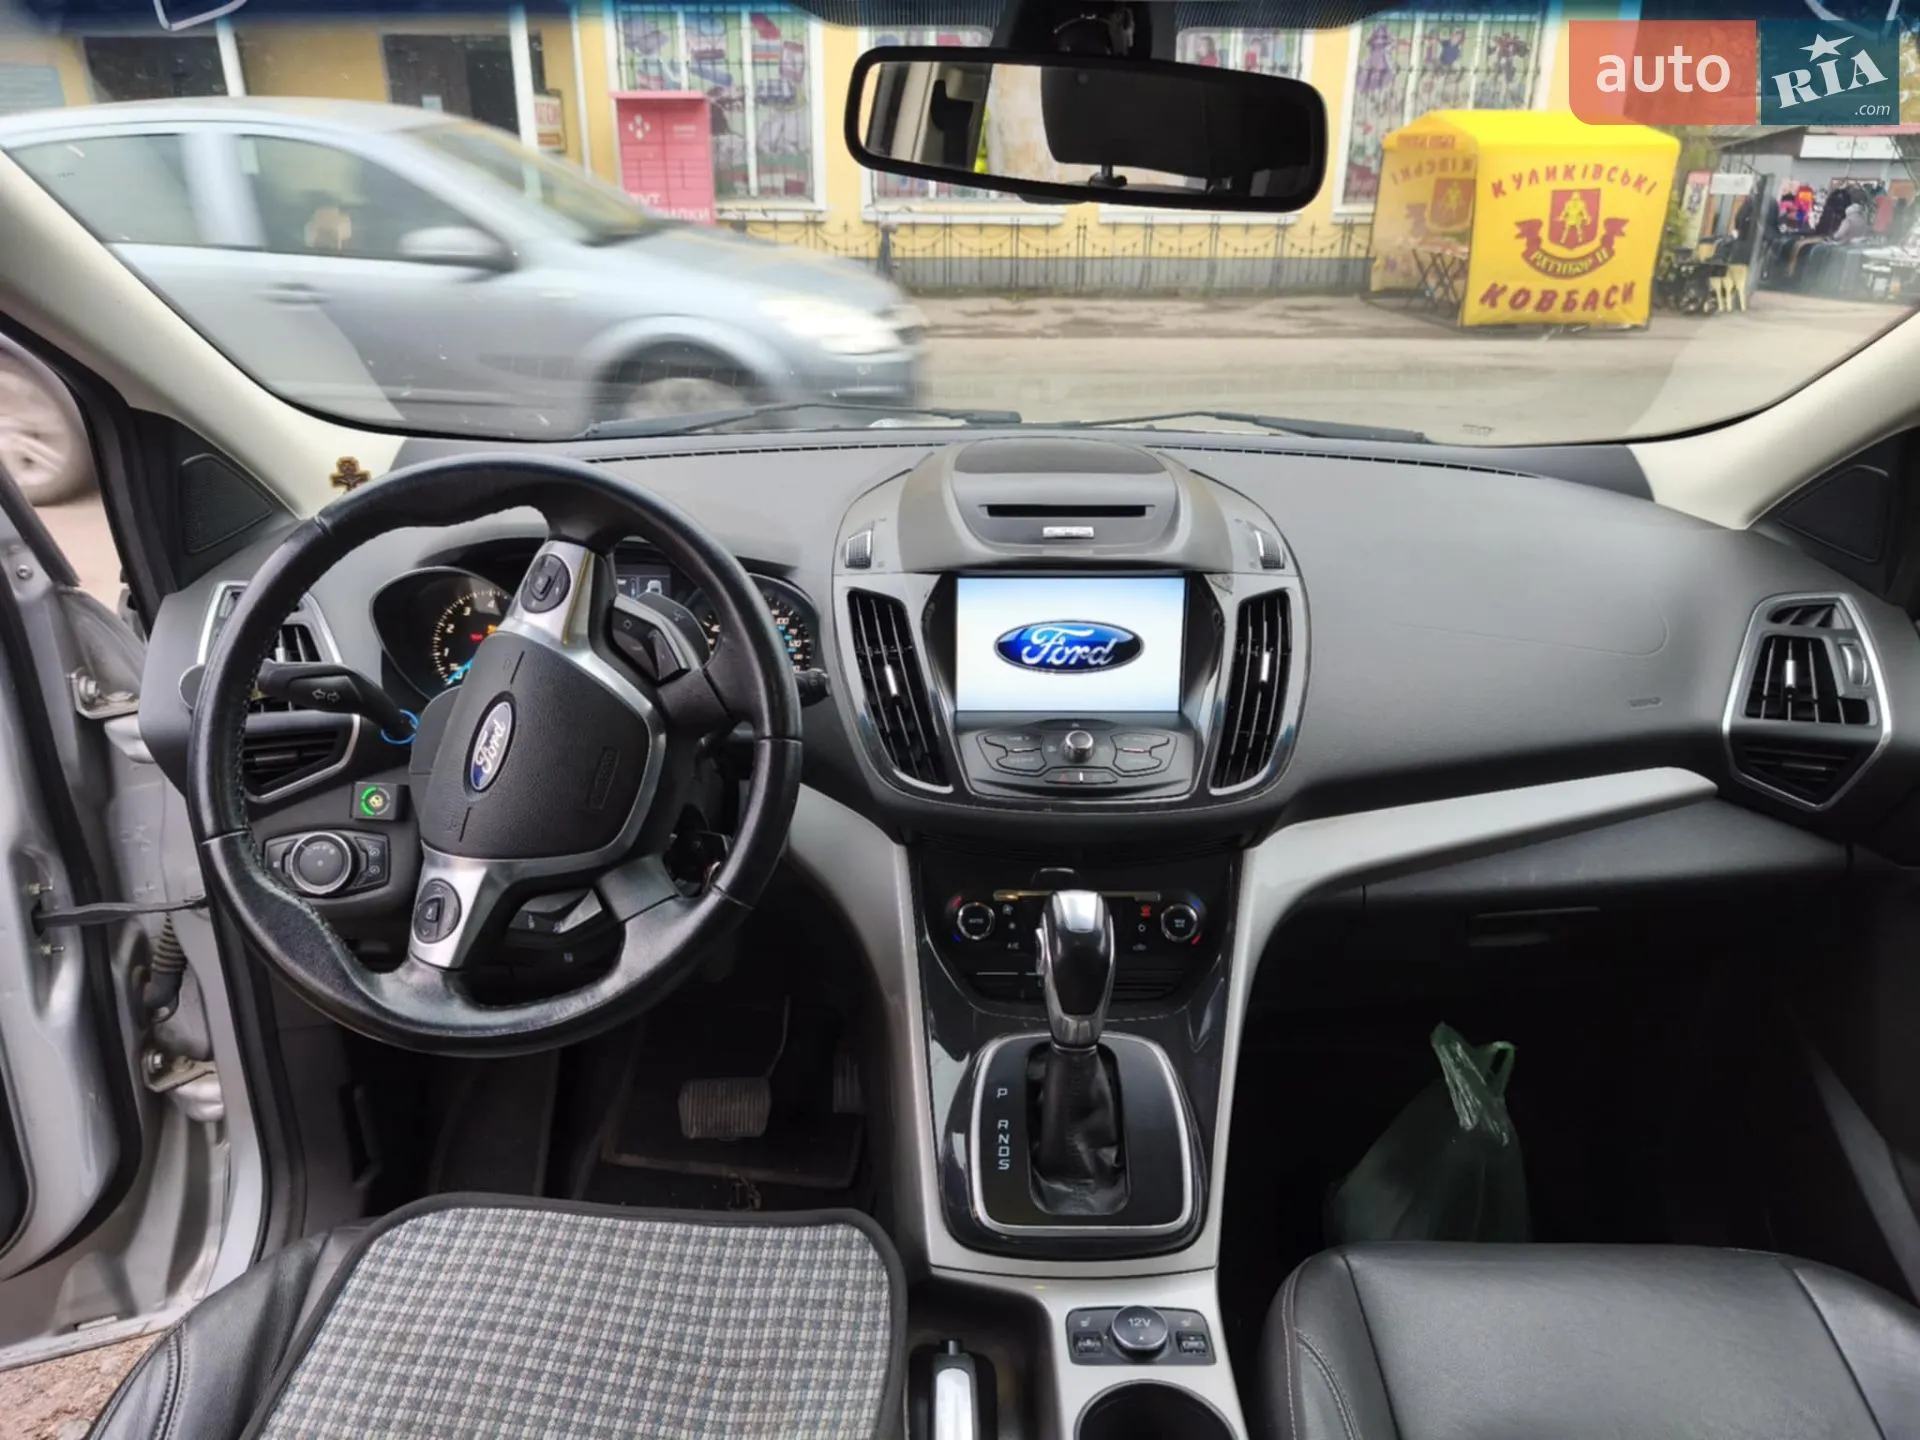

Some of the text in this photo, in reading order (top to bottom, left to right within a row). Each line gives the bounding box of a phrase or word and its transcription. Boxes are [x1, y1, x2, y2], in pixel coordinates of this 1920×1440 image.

[1491, 163, 1657, 199] КУЛИКІВСЬКІ
[1479, 281, 1636, 313] КОВБАСИ
[1021, 626, 1118, 666] Ford
[474, 718, 507, 774] Ford
[997, 1088, 1008, 1098] P
[998, 1119, 1009, 1130] R
[998, 1134, 1009, 1144] N
[998, 1147, 1010, 1157] D
[998, 1159, 1010, 1170] S
[1128, 1317, 1151, 1327] 12V
